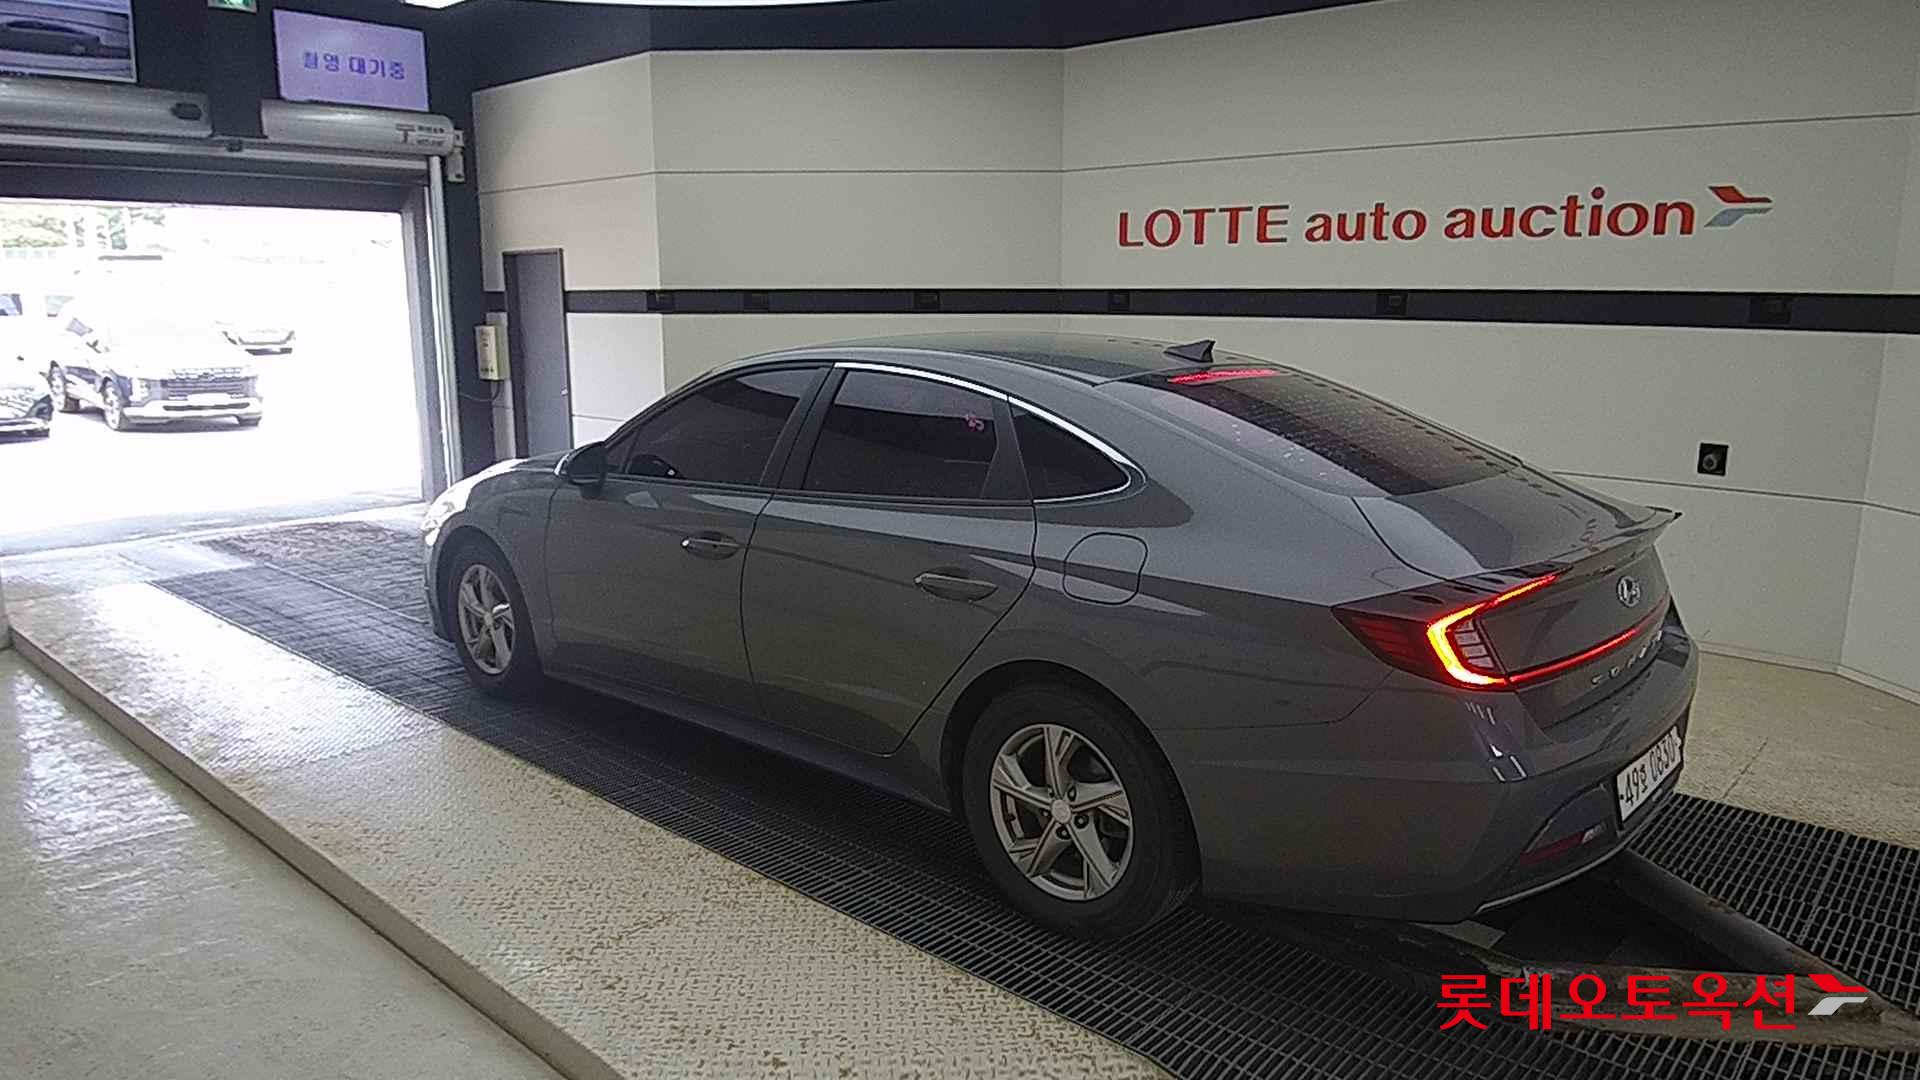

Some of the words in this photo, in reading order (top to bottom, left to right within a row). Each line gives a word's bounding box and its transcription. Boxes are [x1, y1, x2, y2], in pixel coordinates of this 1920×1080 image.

[348, 55, 405, 80] 대기중
[1119, 205, 1290, 246] LOTTE
[1306, 202, 1427, 241] auto
[1444, 186, 1694, 238] auction
